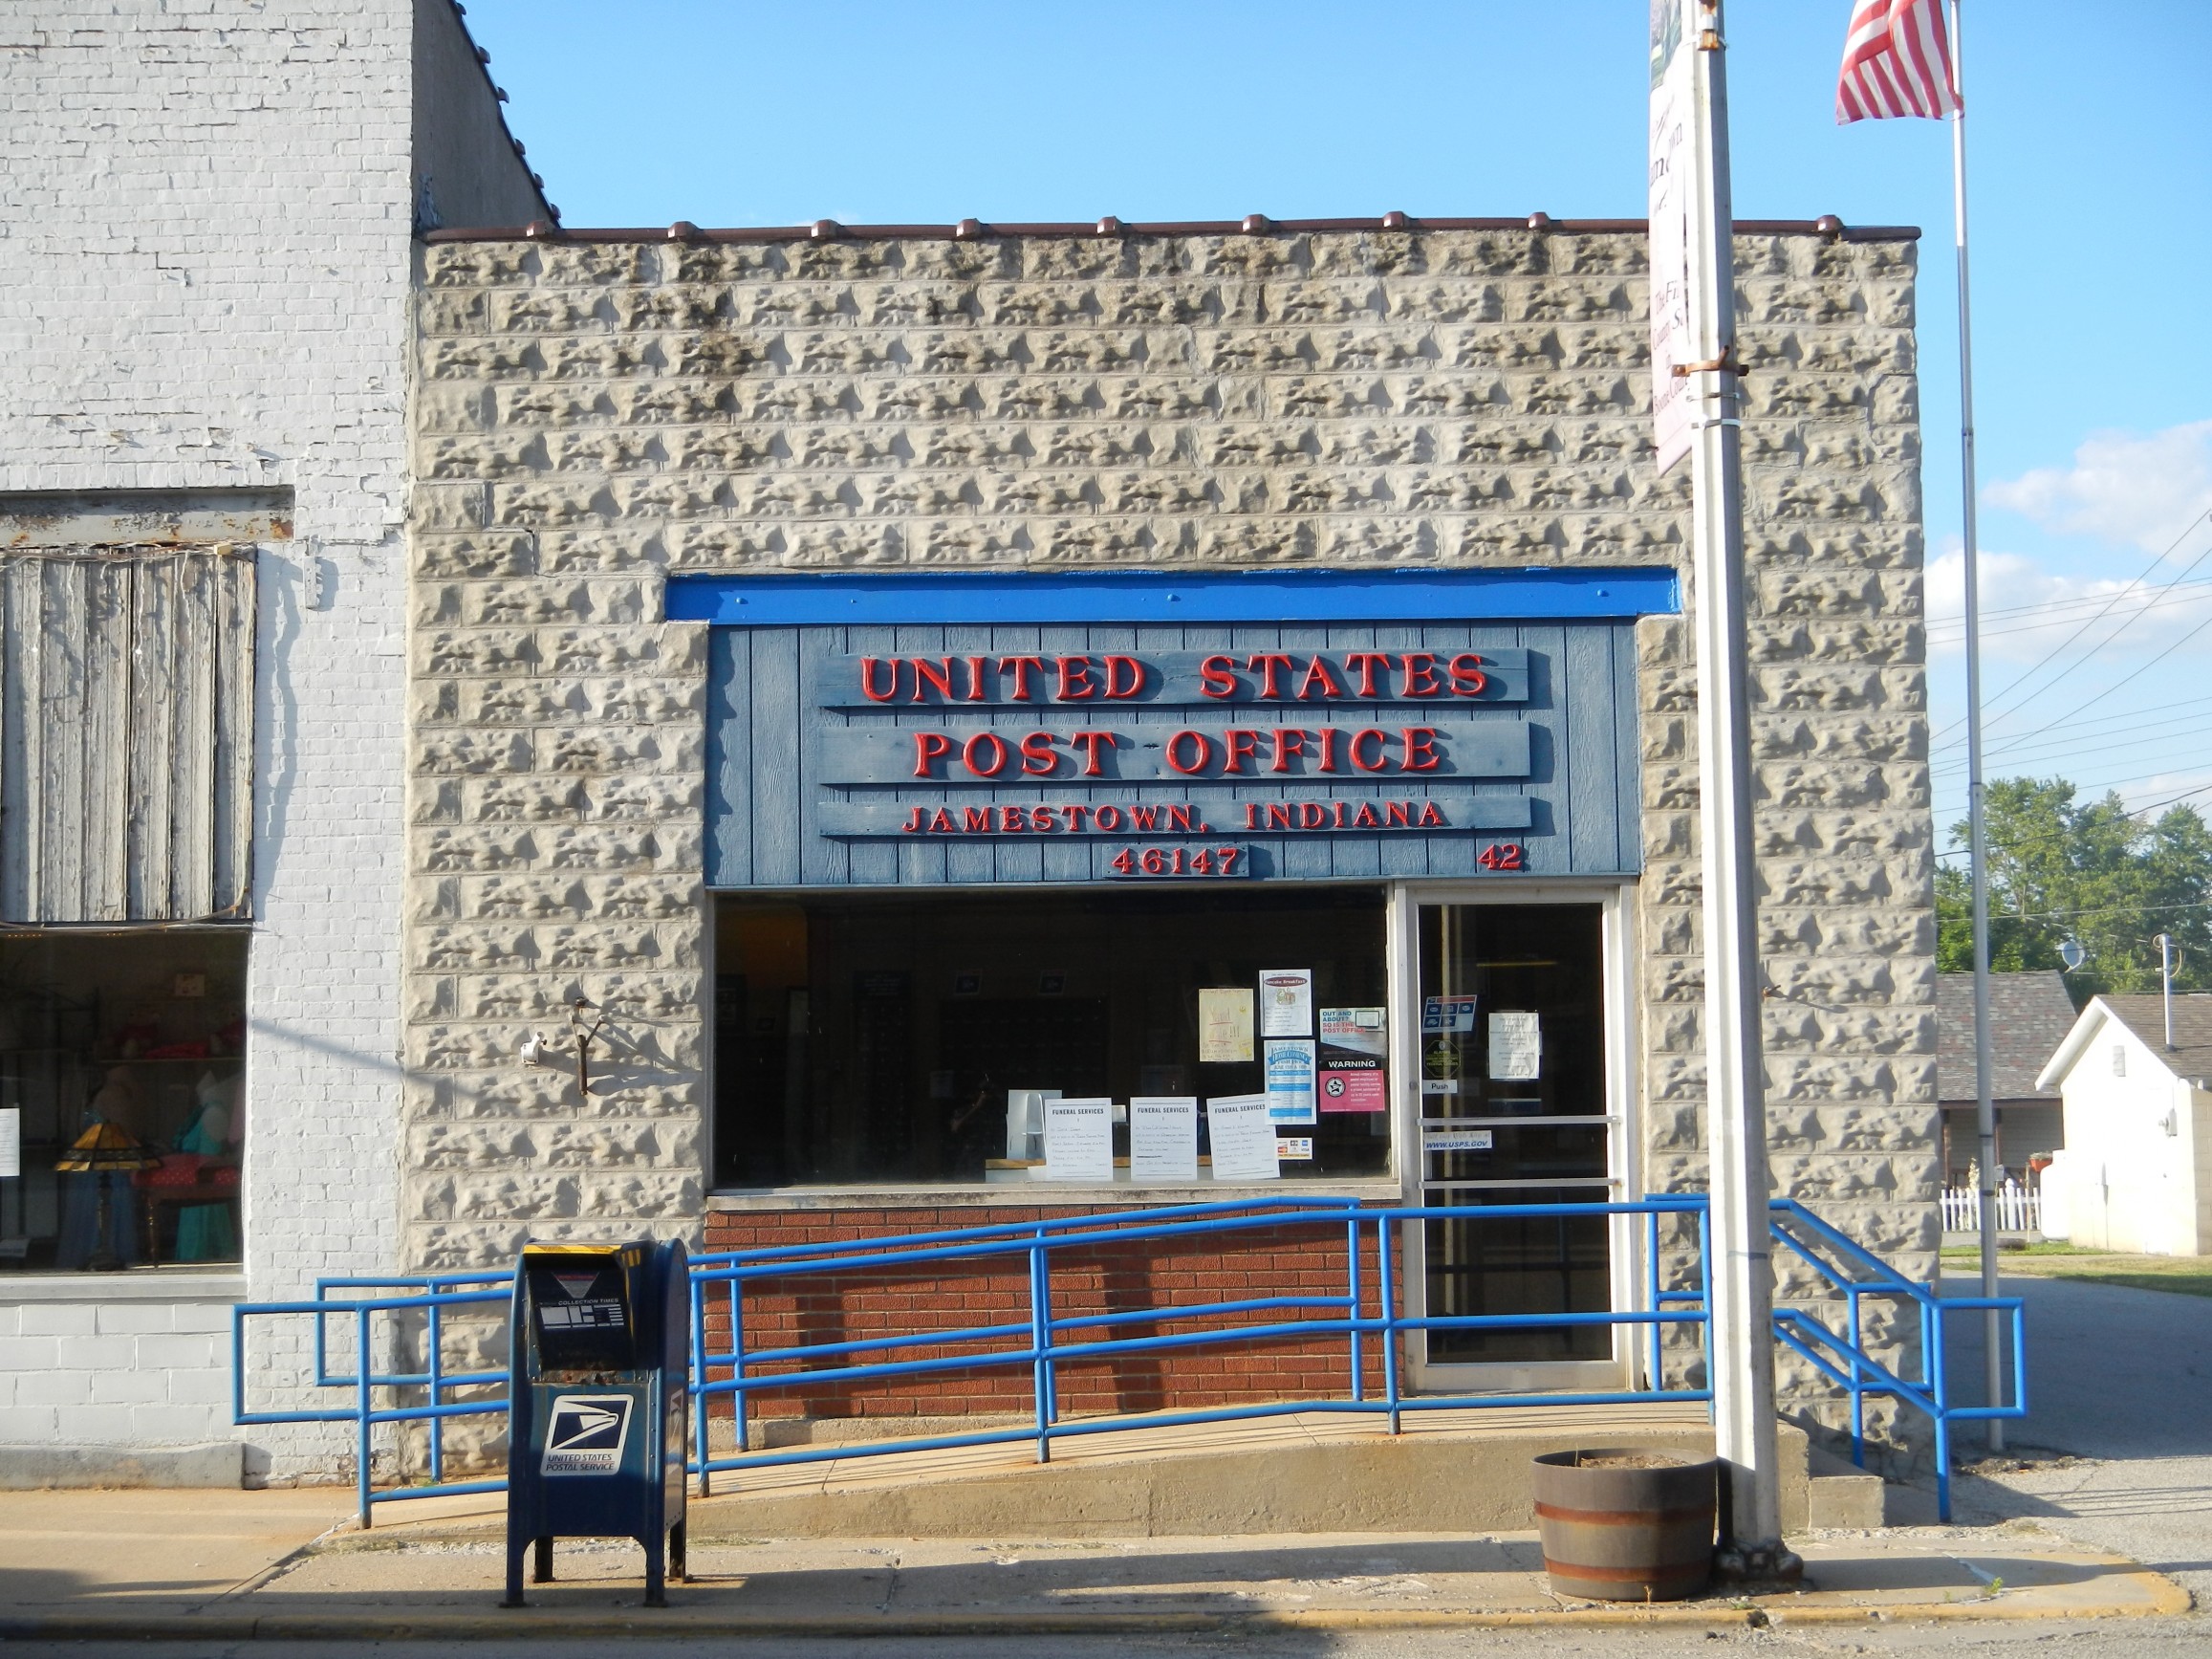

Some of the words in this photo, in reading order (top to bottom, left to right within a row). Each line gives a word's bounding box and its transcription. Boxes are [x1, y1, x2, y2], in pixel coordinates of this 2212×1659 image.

[860, 656, 1144, 702] UNITED
[1201, 654, 1486, 699] STATES
[913, 731, 1116, 777] POST
[1166, 727, 1439, 775] OFFICE
[902, 804, 1208, 833] JAMESTOWN,
[1246, 801, 1442, 830] INDIANA
[1112, 847, 1238, 875] 46147
[1478, 843, 1522, 871] 42
[1328, 1059, 1377, 1068] WARNING
[1240, 1103, 1266, 1112] SERVICES
[1425, 1140, 1488, 1148] WWW.USPS.GOV
[546, 1463, 577, 1472] POSTAL
[579, 1462, 615, 1471] SERVICE
[548, 1453, 581, 1462] UNITED
